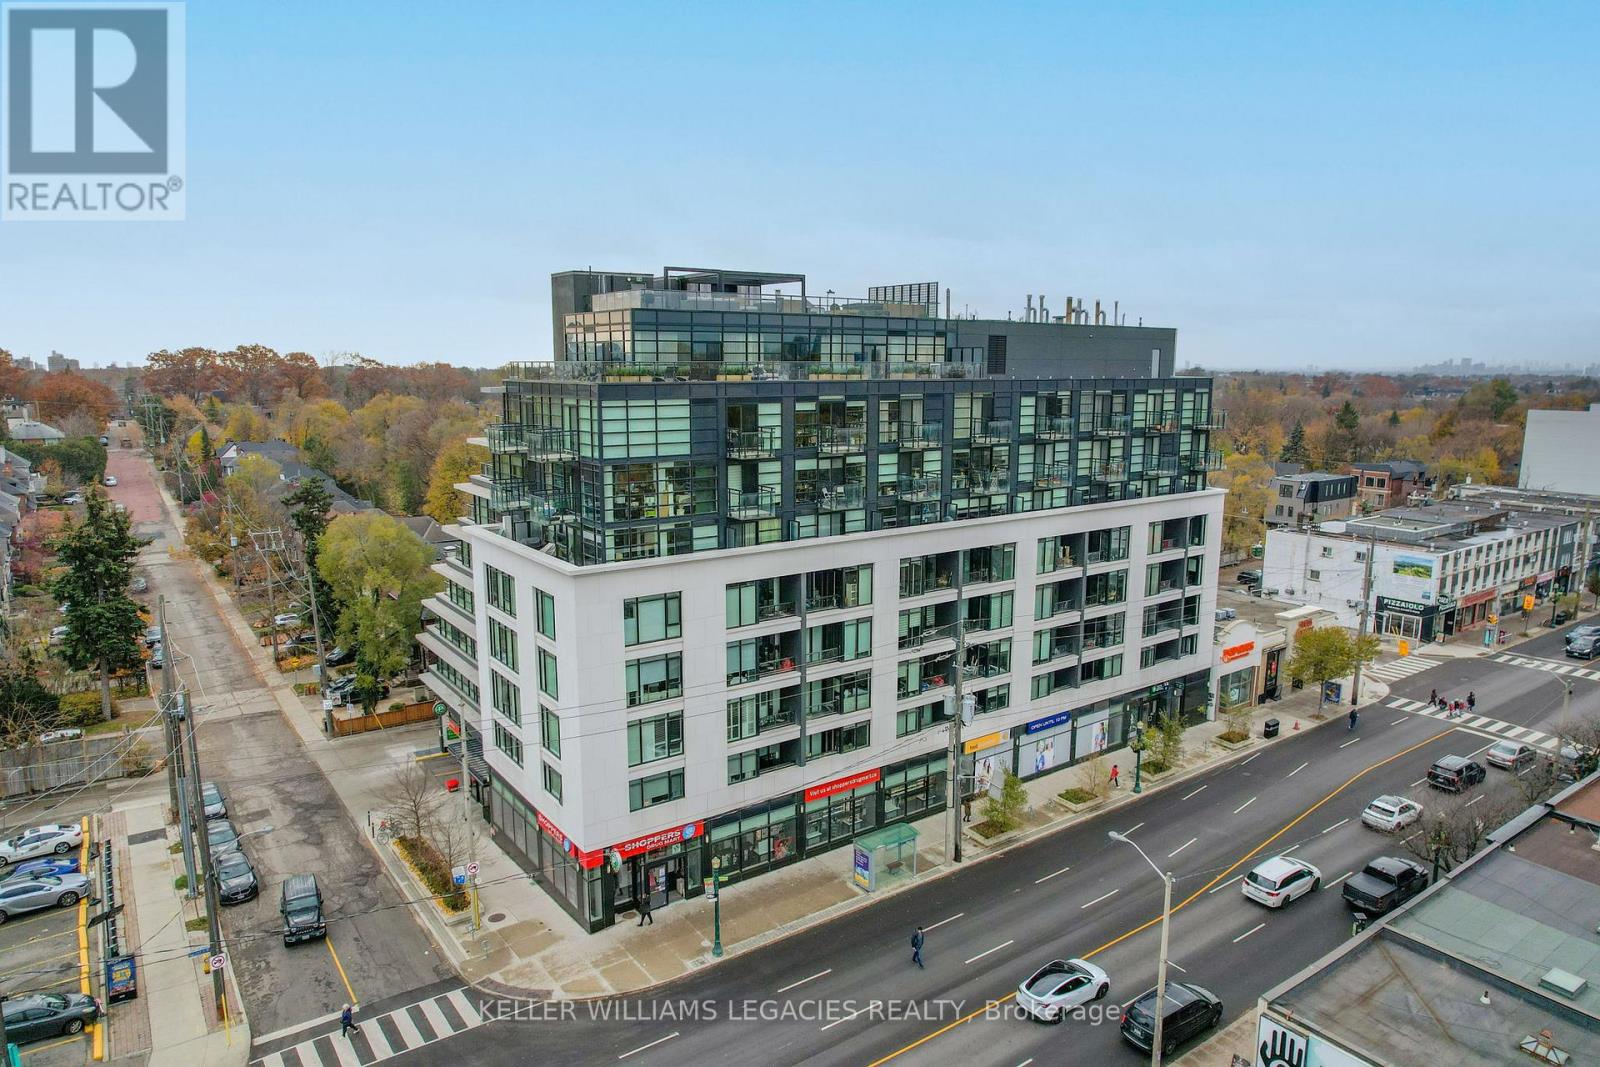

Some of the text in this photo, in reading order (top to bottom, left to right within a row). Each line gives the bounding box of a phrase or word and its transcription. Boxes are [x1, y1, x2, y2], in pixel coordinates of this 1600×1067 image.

[1383, 598, 1425, 611] PIZZAIOLO
[1030, 722, 1043, 731] OPEN
[1044, 719, 1055, 728] UNTIL
[624, 829, 681, 852] SHOPPERS
[646, 836, 681, 850] DRUG MART
